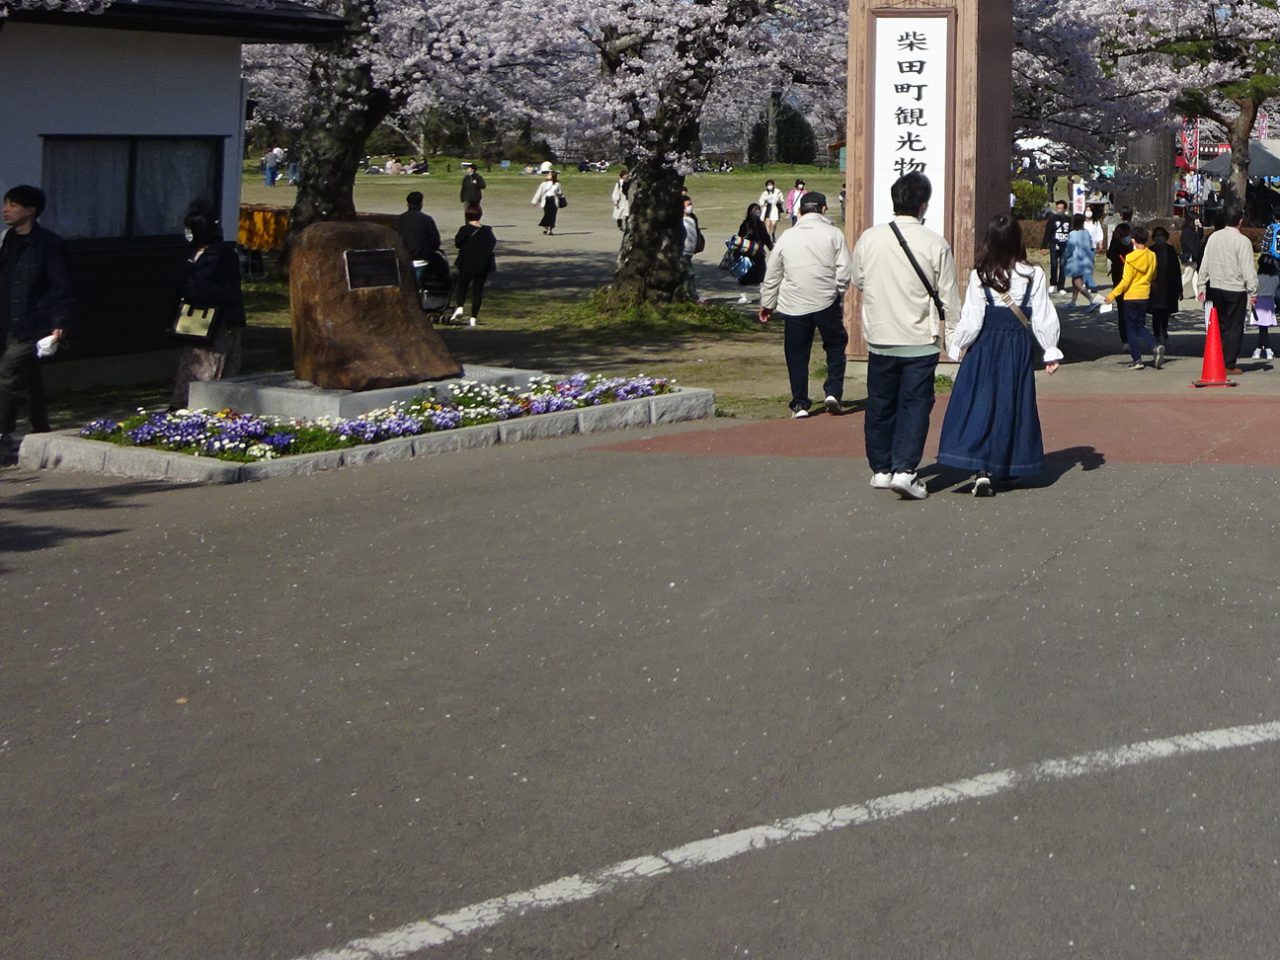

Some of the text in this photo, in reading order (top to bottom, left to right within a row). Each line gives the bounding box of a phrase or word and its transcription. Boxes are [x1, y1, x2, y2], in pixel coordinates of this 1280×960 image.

[893, 31, 930, 225] 柴田町観光物
